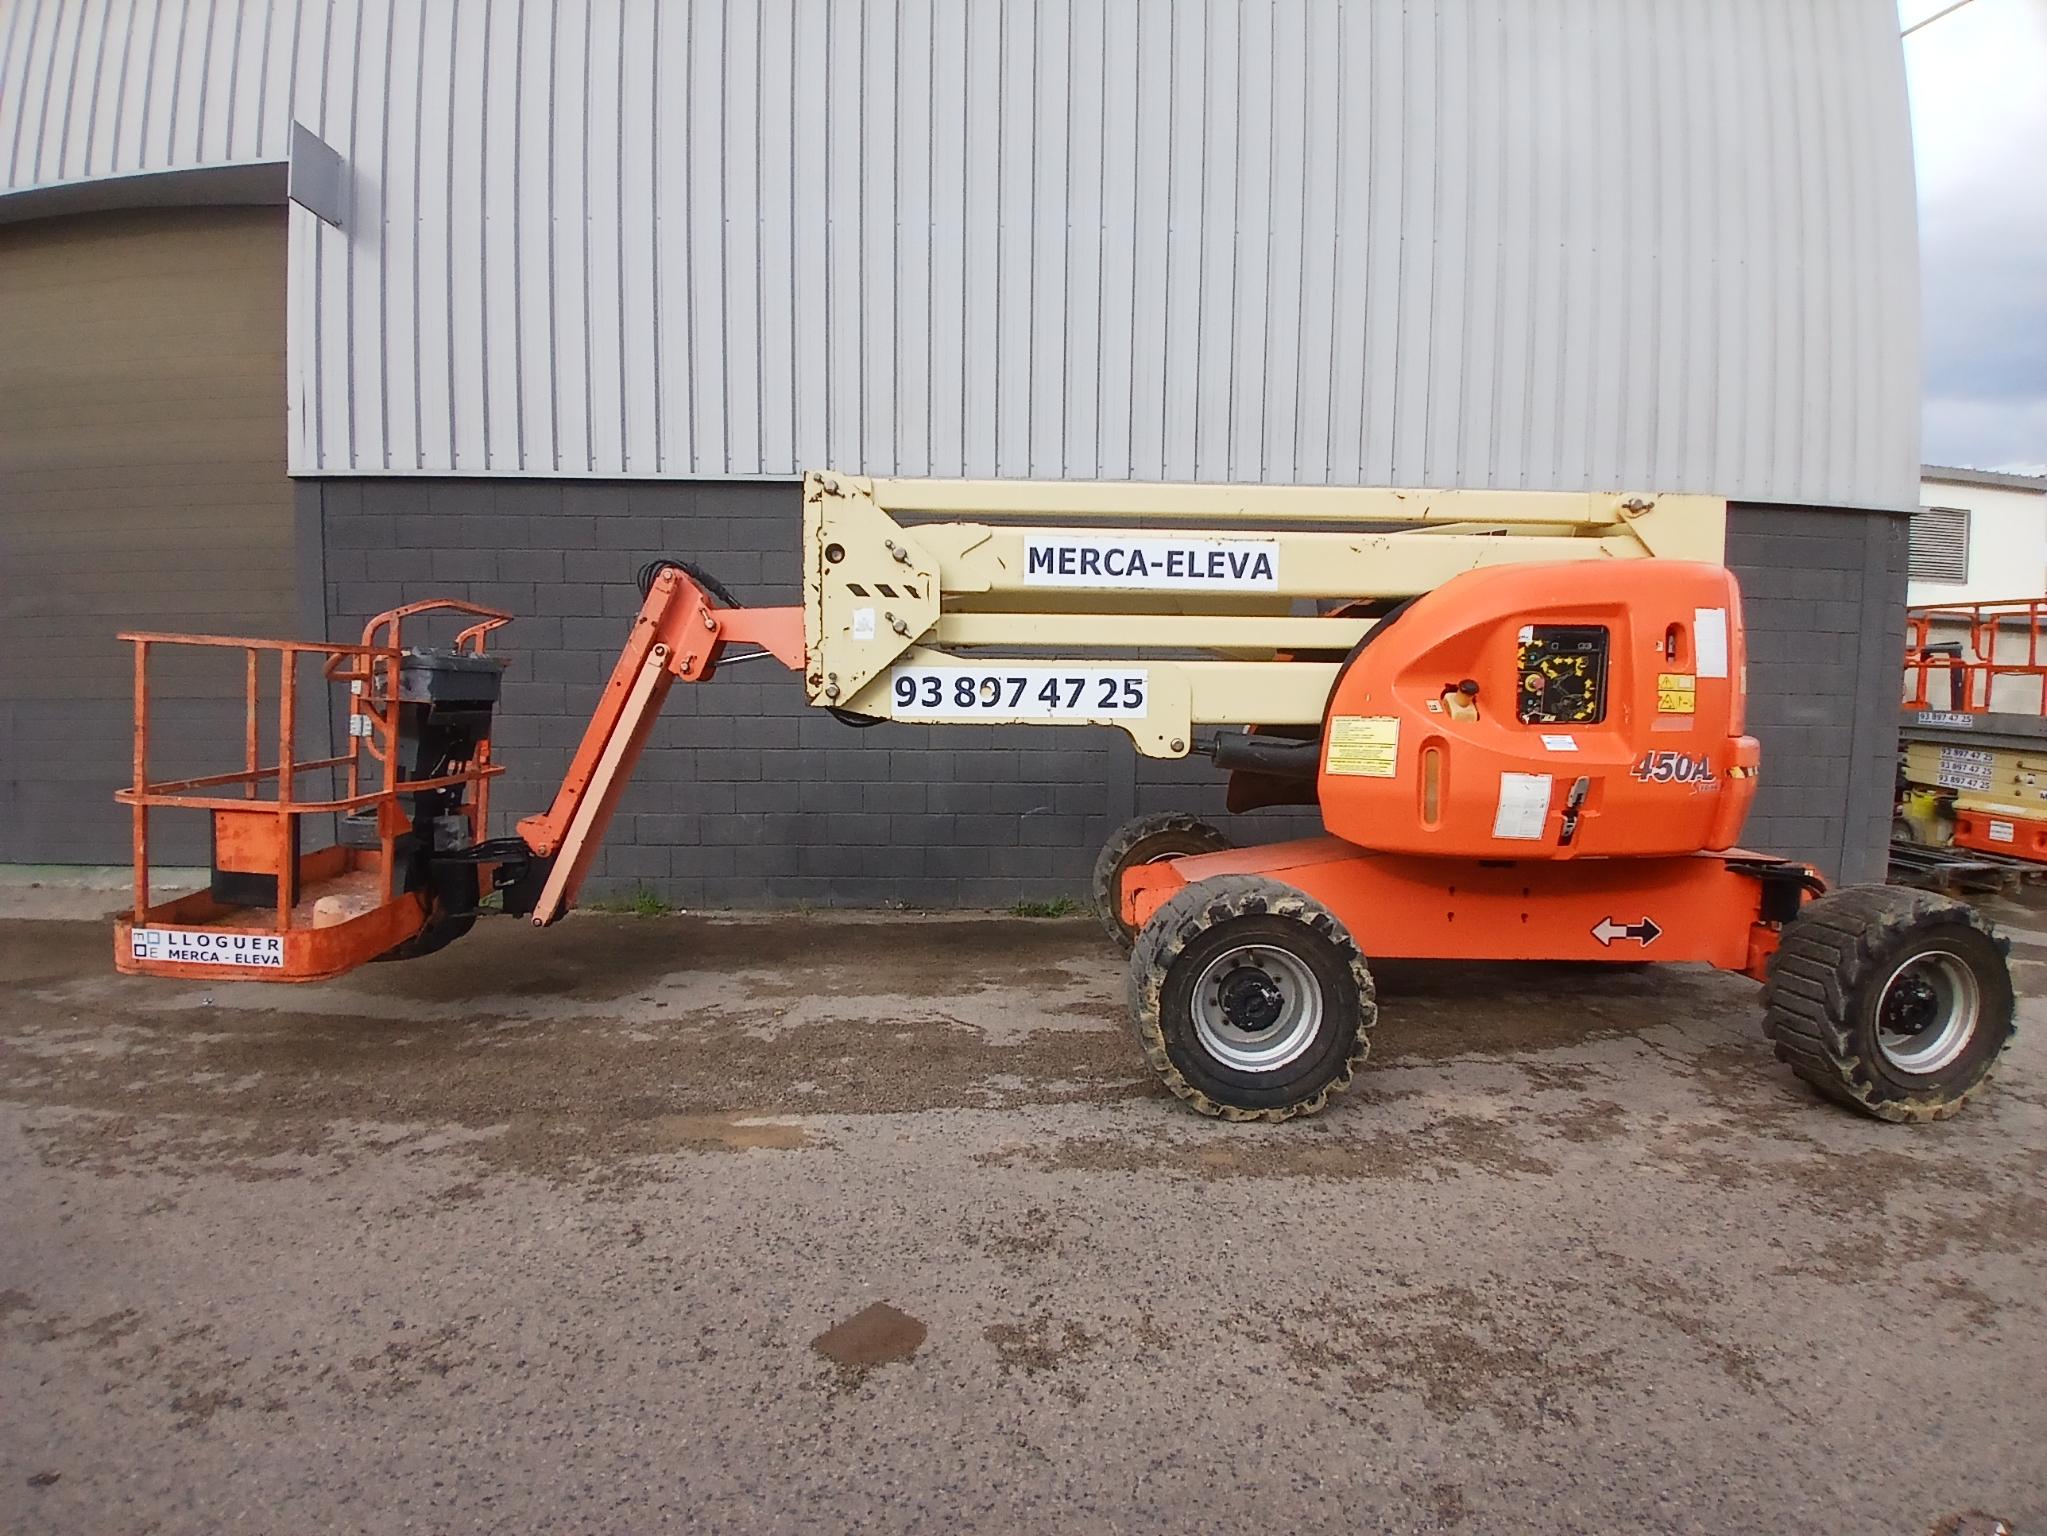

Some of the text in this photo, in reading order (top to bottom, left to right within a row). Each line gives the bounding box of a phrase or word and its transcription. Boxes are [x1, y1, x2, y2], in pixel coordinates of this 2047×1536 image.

[1029, 546, 1273, 580] MERCA-ELEVA
[895, 676, 1144, 709] 93 897 47 25
[1631, 750, 1716, 782] 450A
[168, 932, 280, 951] LLOGUER
[168, 949, 220, 962] MERCA
[235, 953, 281, 966] ELEVA
